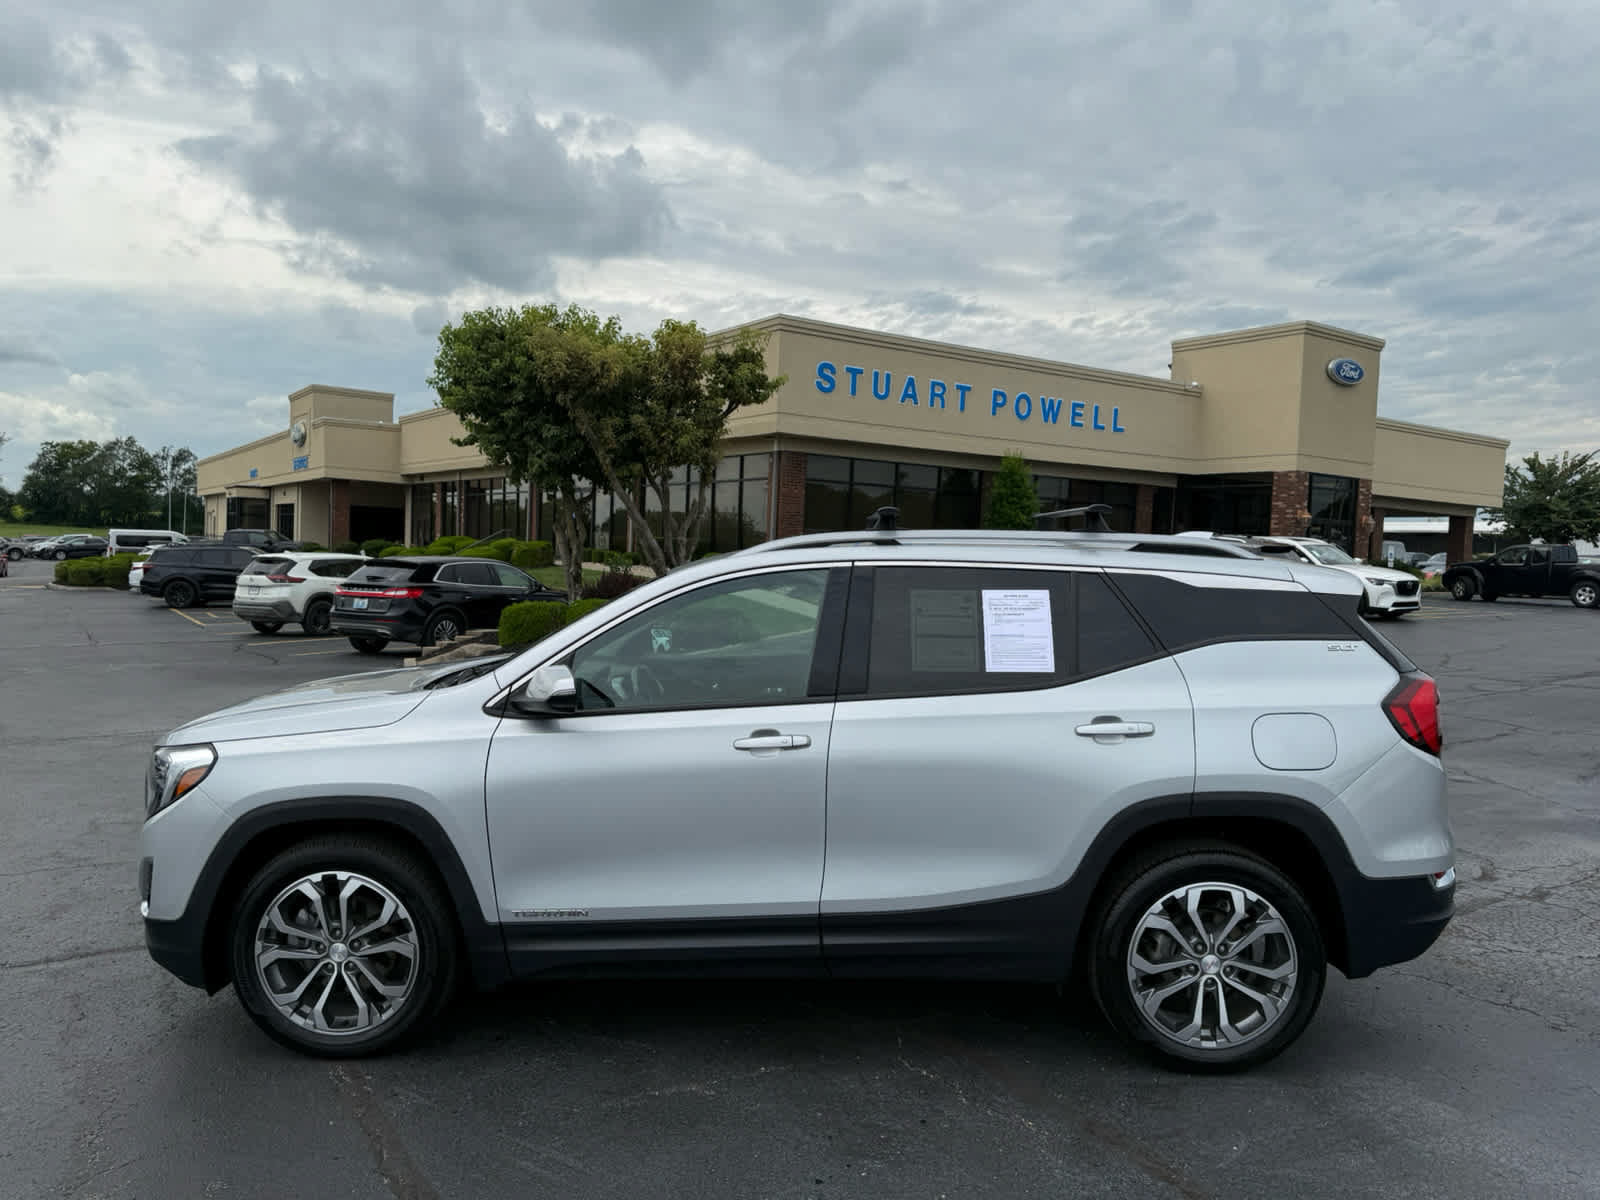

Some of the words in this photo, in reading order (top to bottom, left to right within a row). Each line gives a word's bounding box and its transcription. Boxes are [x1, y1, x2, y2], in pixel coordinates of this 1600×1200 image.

[1339, 362, 1361, 379] Ford
[815, 361, 973, 413] STUART
[991, 388, 1126, 433] POWELL
